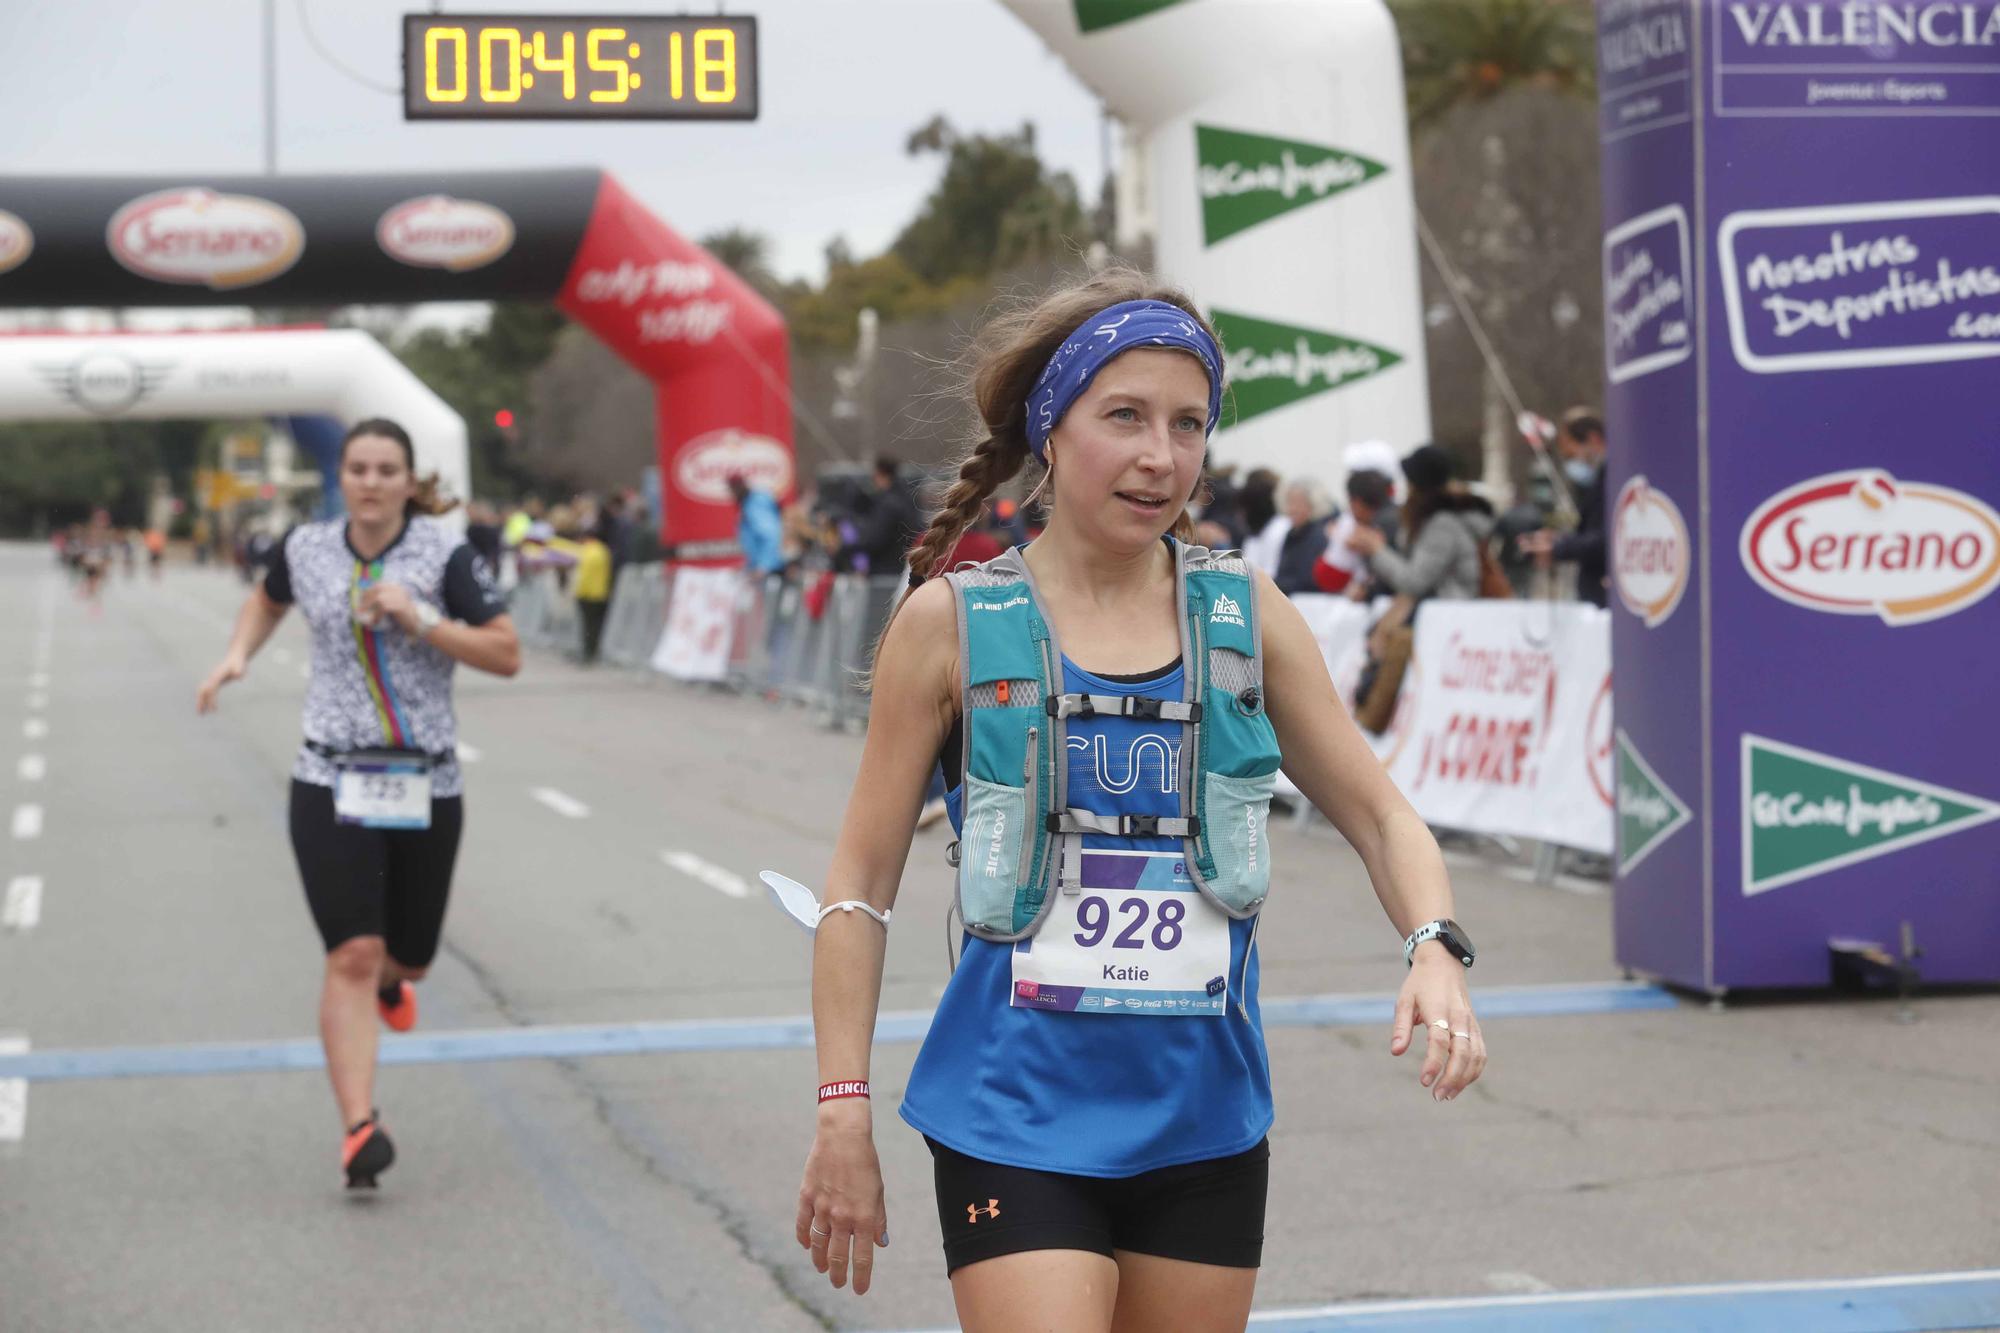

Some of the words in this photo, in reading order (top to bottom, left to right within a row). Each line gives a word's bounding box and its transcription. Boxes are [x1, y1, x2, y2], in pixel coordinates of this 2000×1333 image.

[1776, 517, 1984, 573] Serrano
[973, 602, 983, 611] AIR
[984, 603, 1002, 611] WIND
[1003, 597, 1029, 609] TRACKER
[1073, 895, 1186, 951] 928
[1103, 964, 1149, 981] Katie
[820, 1082, 870, 1099] VALENCIA
